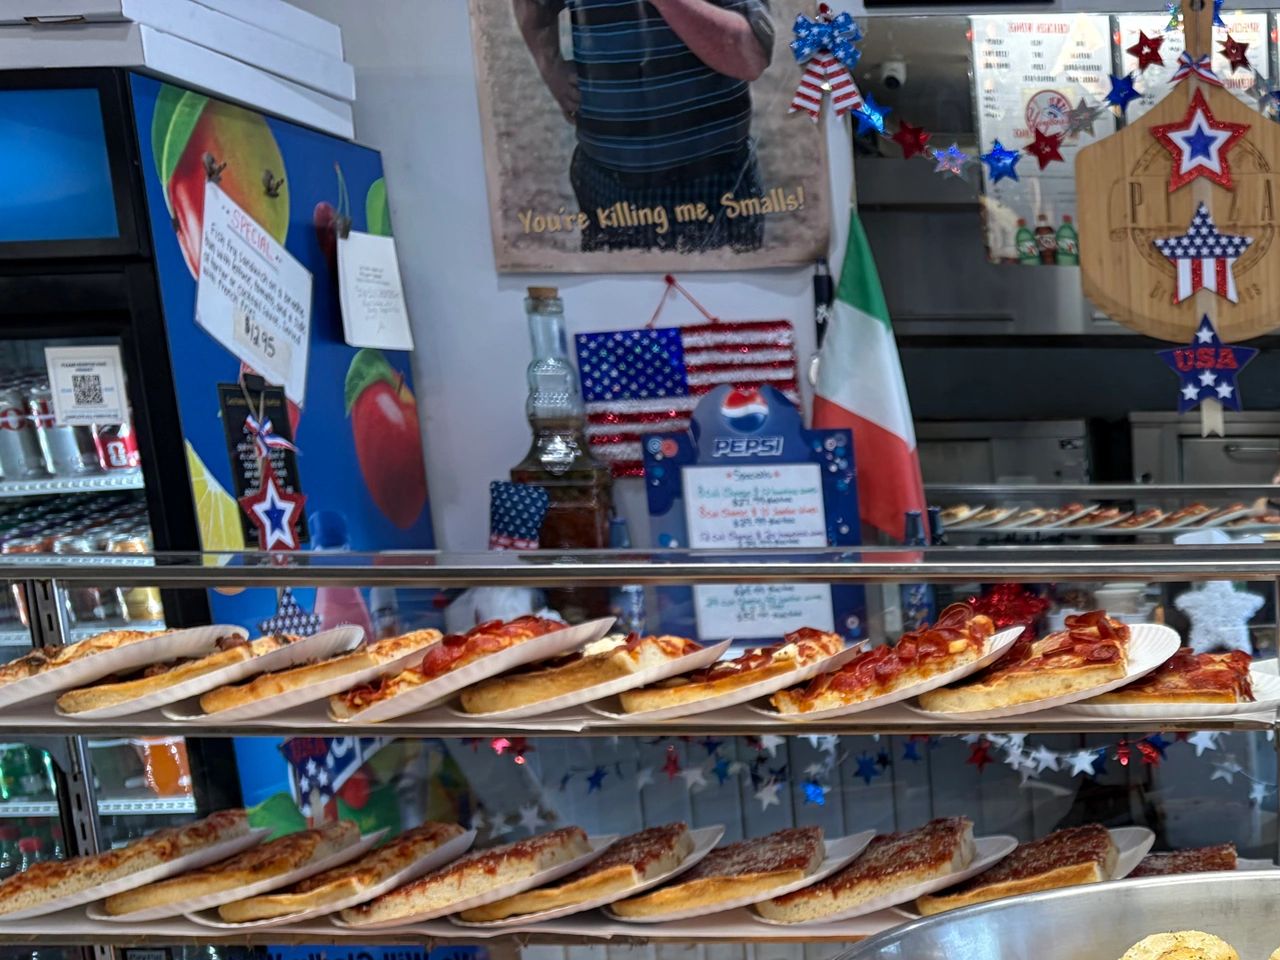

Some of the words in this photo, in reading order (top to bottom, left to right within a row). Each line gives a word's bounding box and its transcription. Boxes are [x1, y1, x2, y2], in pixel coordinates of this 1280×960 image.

[518, 207, 590, 233] You're
[674, 202, 715, 224] me,
[720, 185, 806, 219] Smalls!
[1130, 179, 1275, 225] PIZA
[1172, 347, 1239, 372] USA
[712, 436, 784, 457] PEPSI
